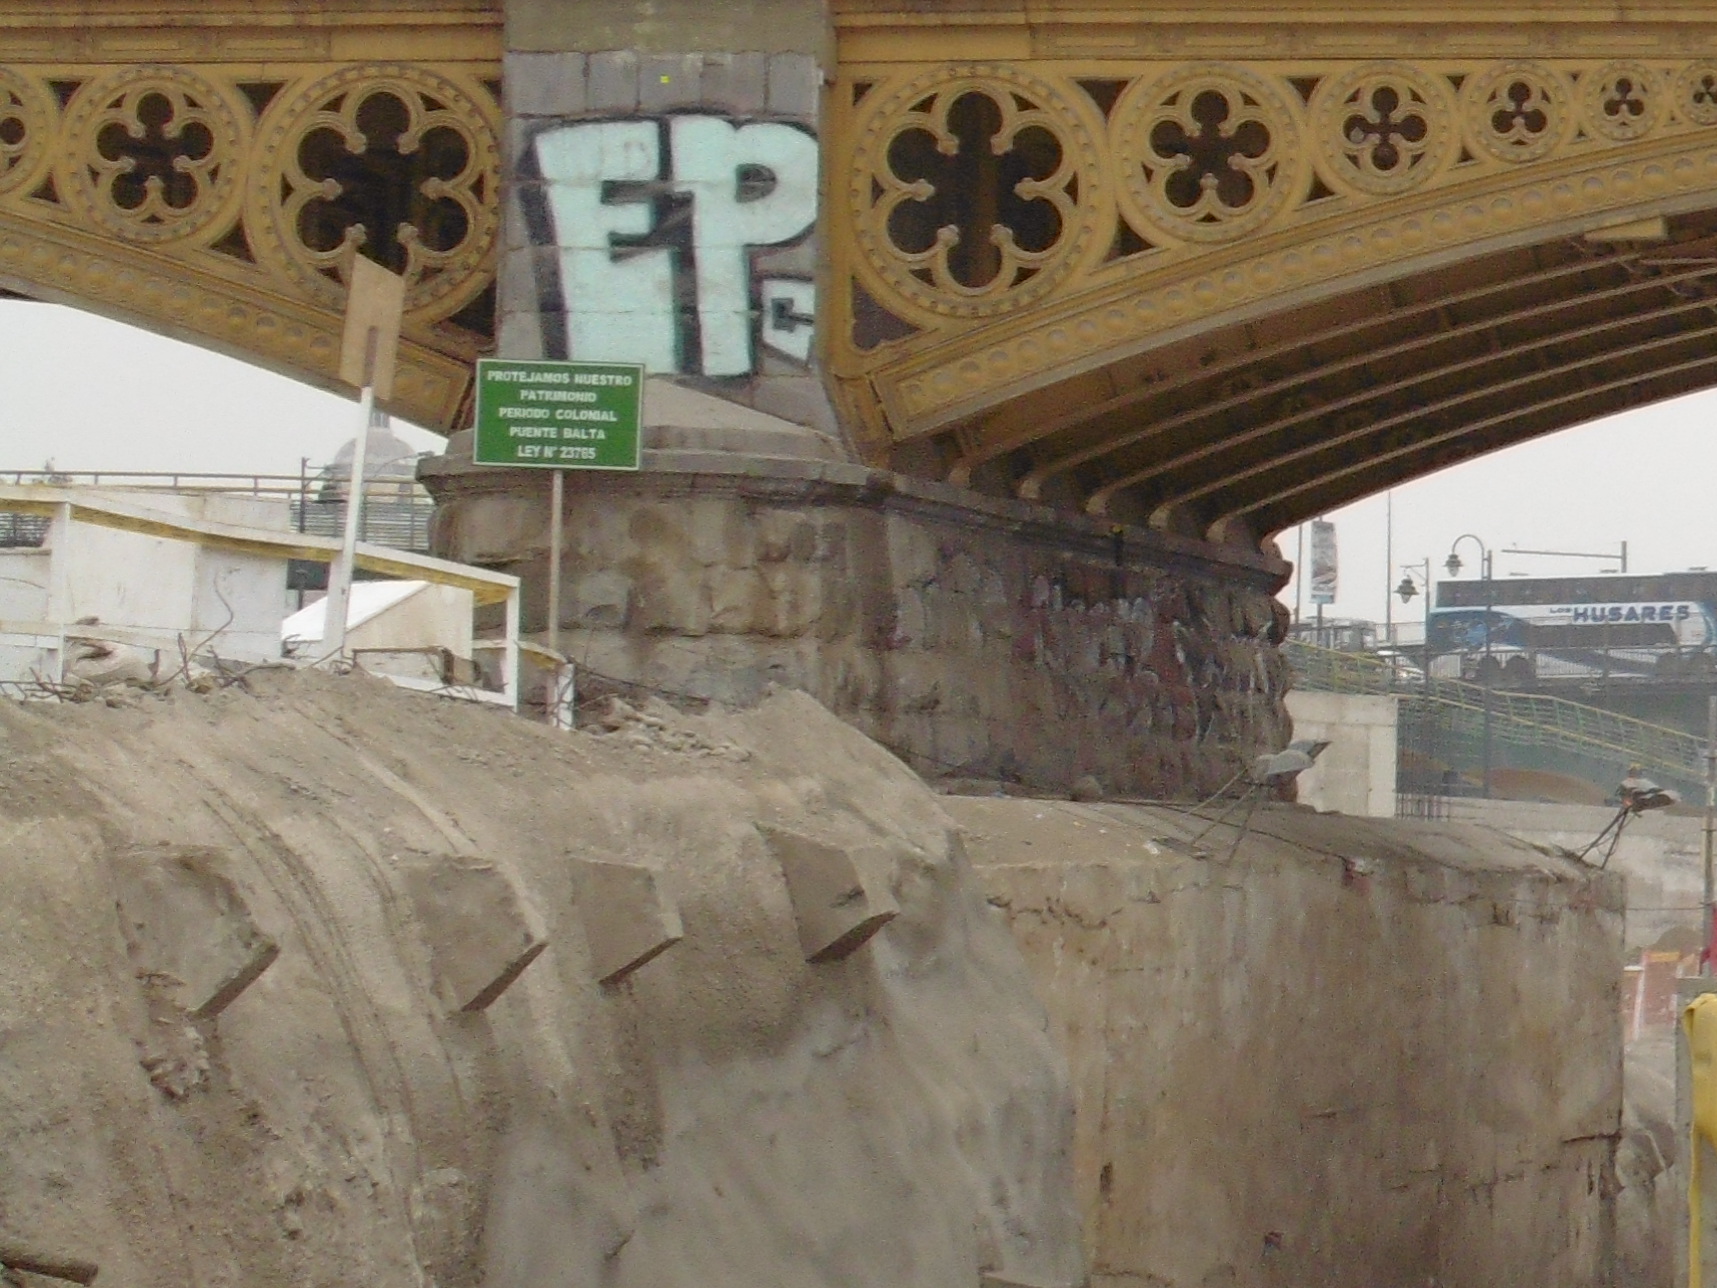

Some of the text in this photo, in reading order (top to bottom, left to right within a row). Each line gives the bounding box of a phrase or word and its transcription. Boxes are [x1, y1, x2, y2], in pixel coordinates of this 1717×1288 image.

[487, 370, 633, 386] PROTEJAMOS NUESTRO
[520, 389, 597, 402] PATRIMONIO
[499, 407, 617, 422] PERIODO COLONIAL
[509, 426, 606, 439] PUENTE BALTA
[517, 445, 540, 457] LEY
[1573, 605, 1691, 623] HUSARES
